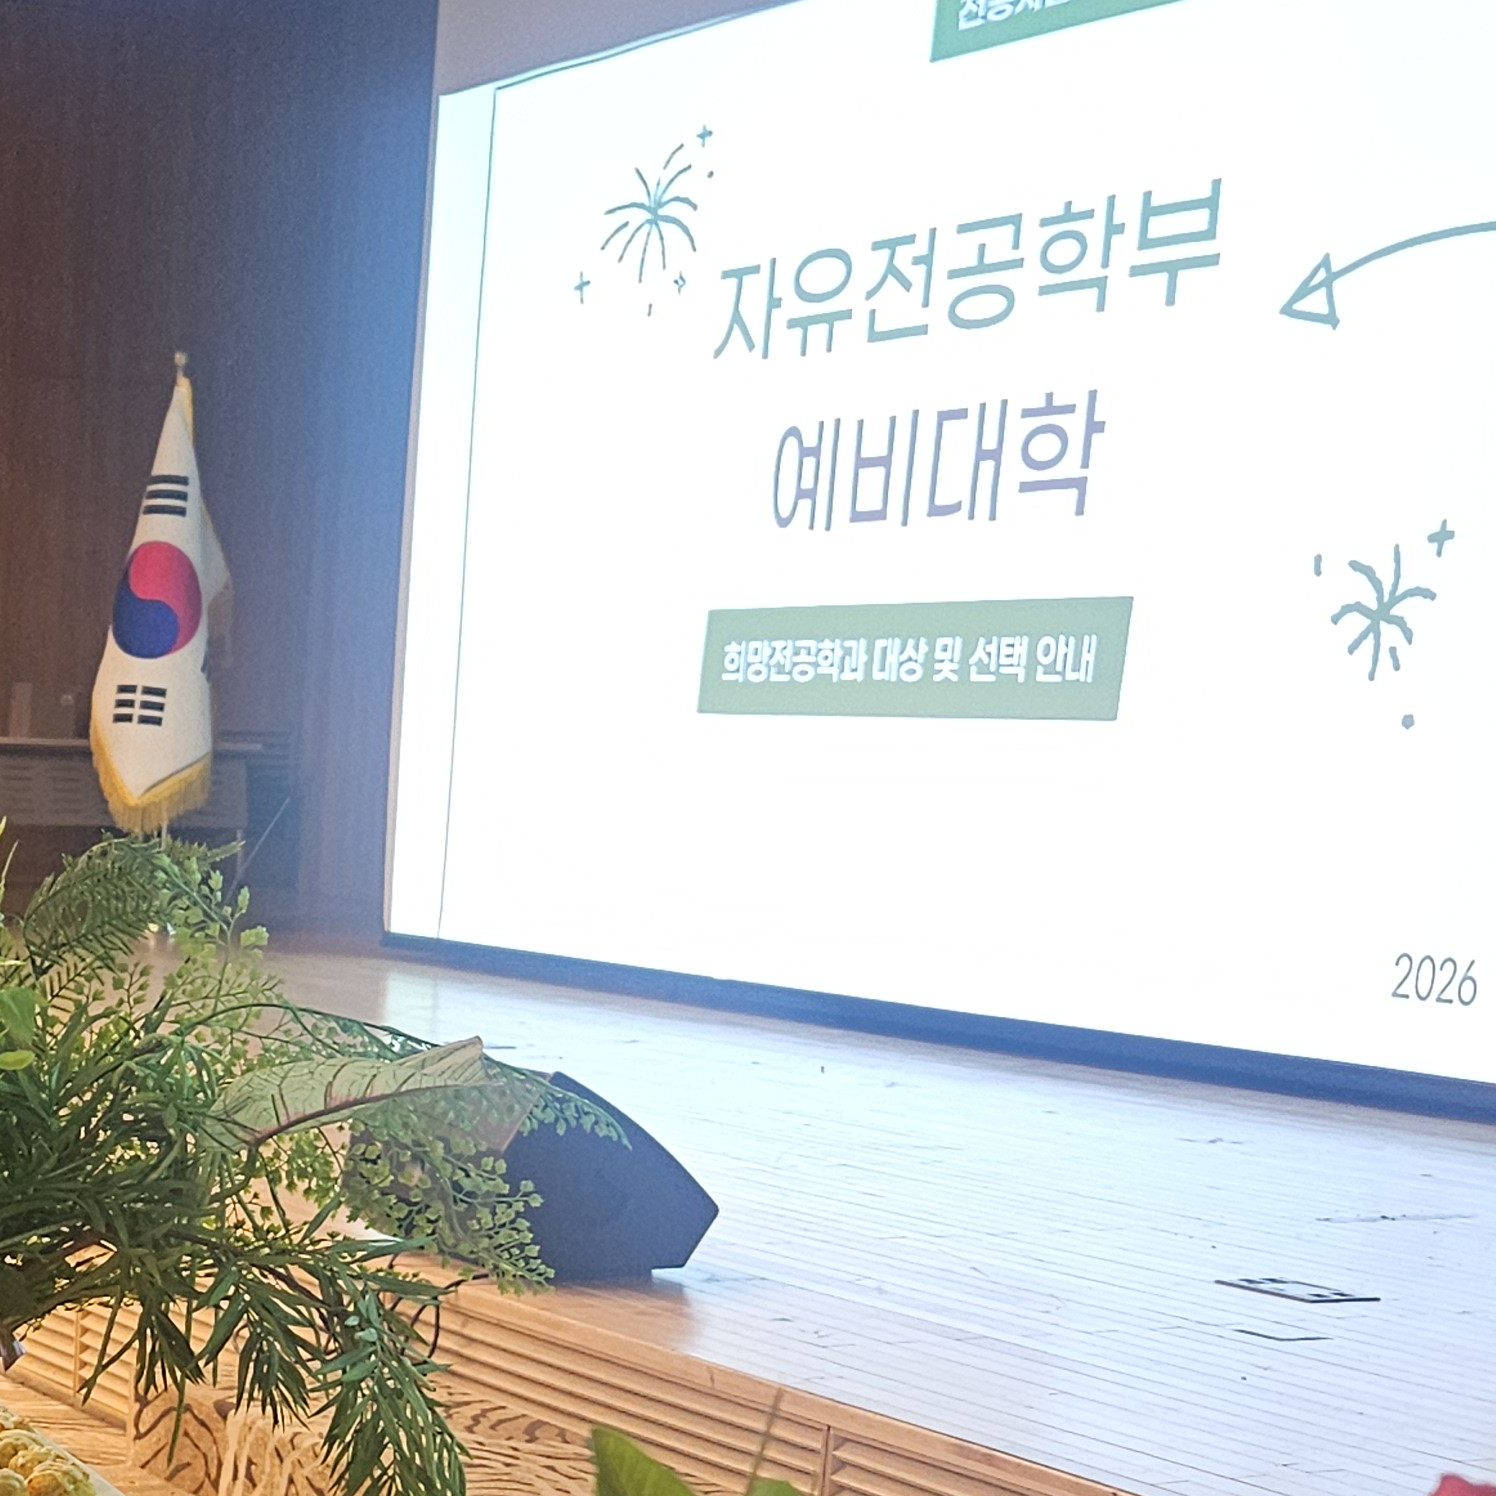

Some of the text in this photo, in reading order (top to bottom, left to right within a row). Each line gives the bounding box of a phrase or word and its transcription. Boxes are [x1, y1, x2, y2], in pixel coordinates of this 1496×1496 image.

[712, 177, 1223, 360] 자유전공학부
[772, 389, 1107, 533] 예비대학
[722, 634, 1098, 684] 희망전공학과 대상 및 선택 안내
[1391, 953, 1478, 1007] 2026
